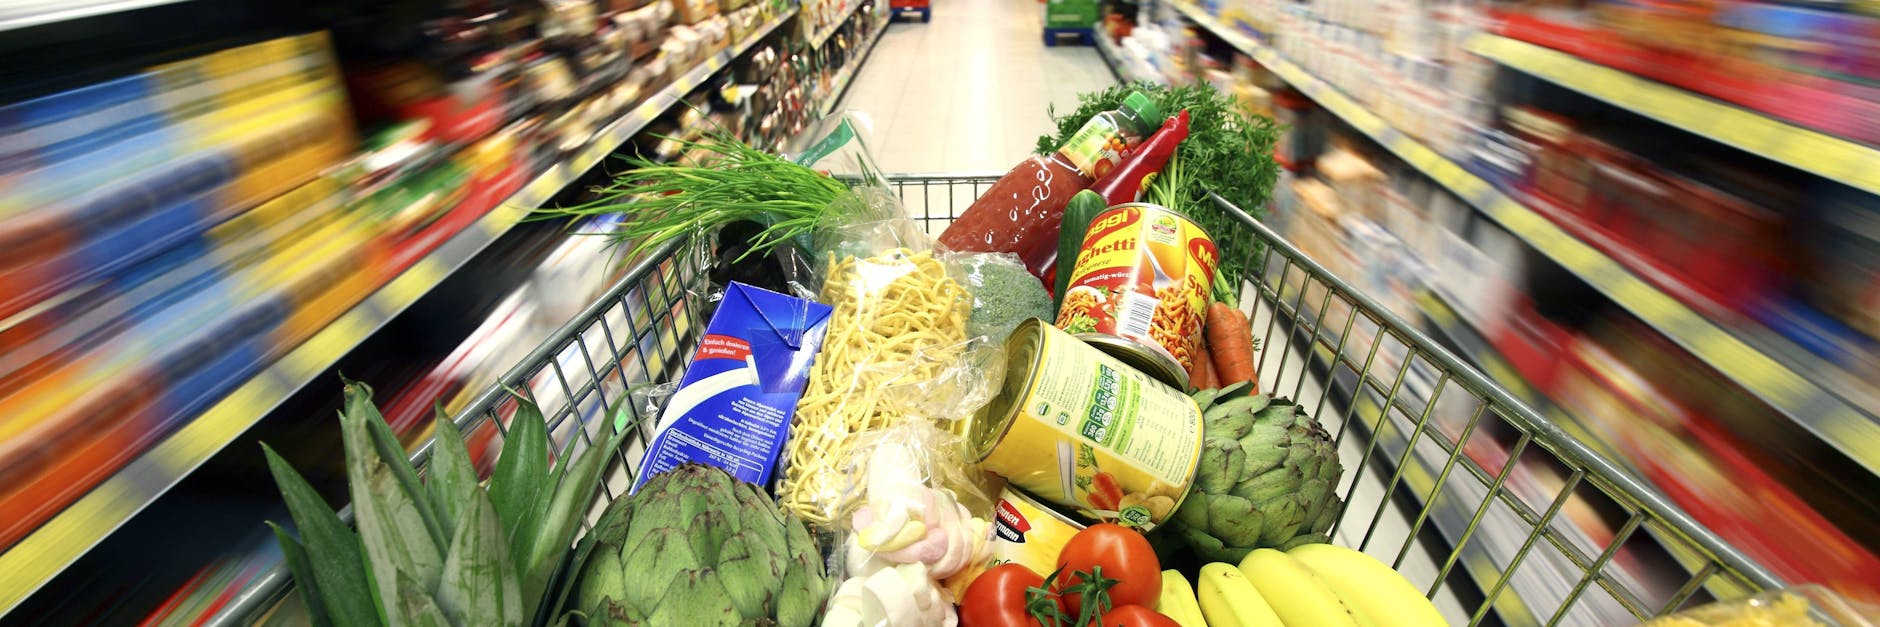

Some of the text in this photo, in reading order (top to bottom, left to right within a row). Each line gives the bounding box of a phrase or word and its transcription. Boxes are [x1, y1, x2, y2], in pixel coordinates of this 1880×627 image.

[1086, 209, 1129, 241] aggi
[1075, 237, 1136, 271] aghetti
[1198, 244, 1216, 274] Ma
[704, 338, 750, 350] Einfach dosieren
[709, 347, 736, 355] genießen!
[1088, 425, 1097, 437] 360
